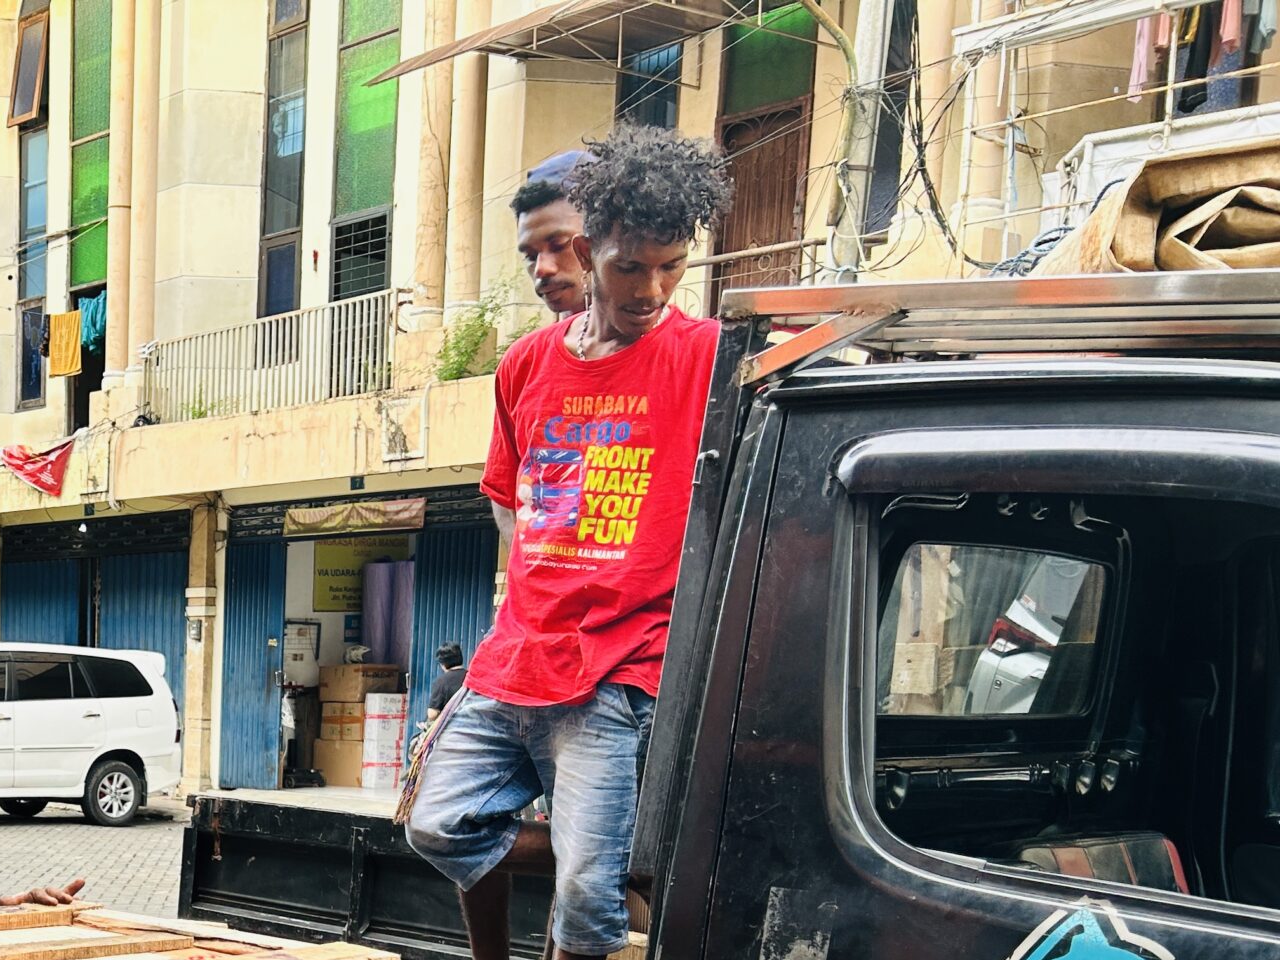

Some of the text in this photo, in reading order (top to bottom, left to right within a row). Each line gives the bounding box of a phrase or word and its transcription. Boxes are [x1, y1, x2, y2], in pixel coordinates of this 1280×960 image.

[562, 395, 649, 416] SURABAYA
[543, 416, 632, 446] Cargo
[583, 445, 655, 470] FRONT
[583, 469, 653, 495] MAKE
[585, 493, 643, 519] YOU
[577, 517, 638, 545] FUN
[318, 568, 329, 577] VIA
